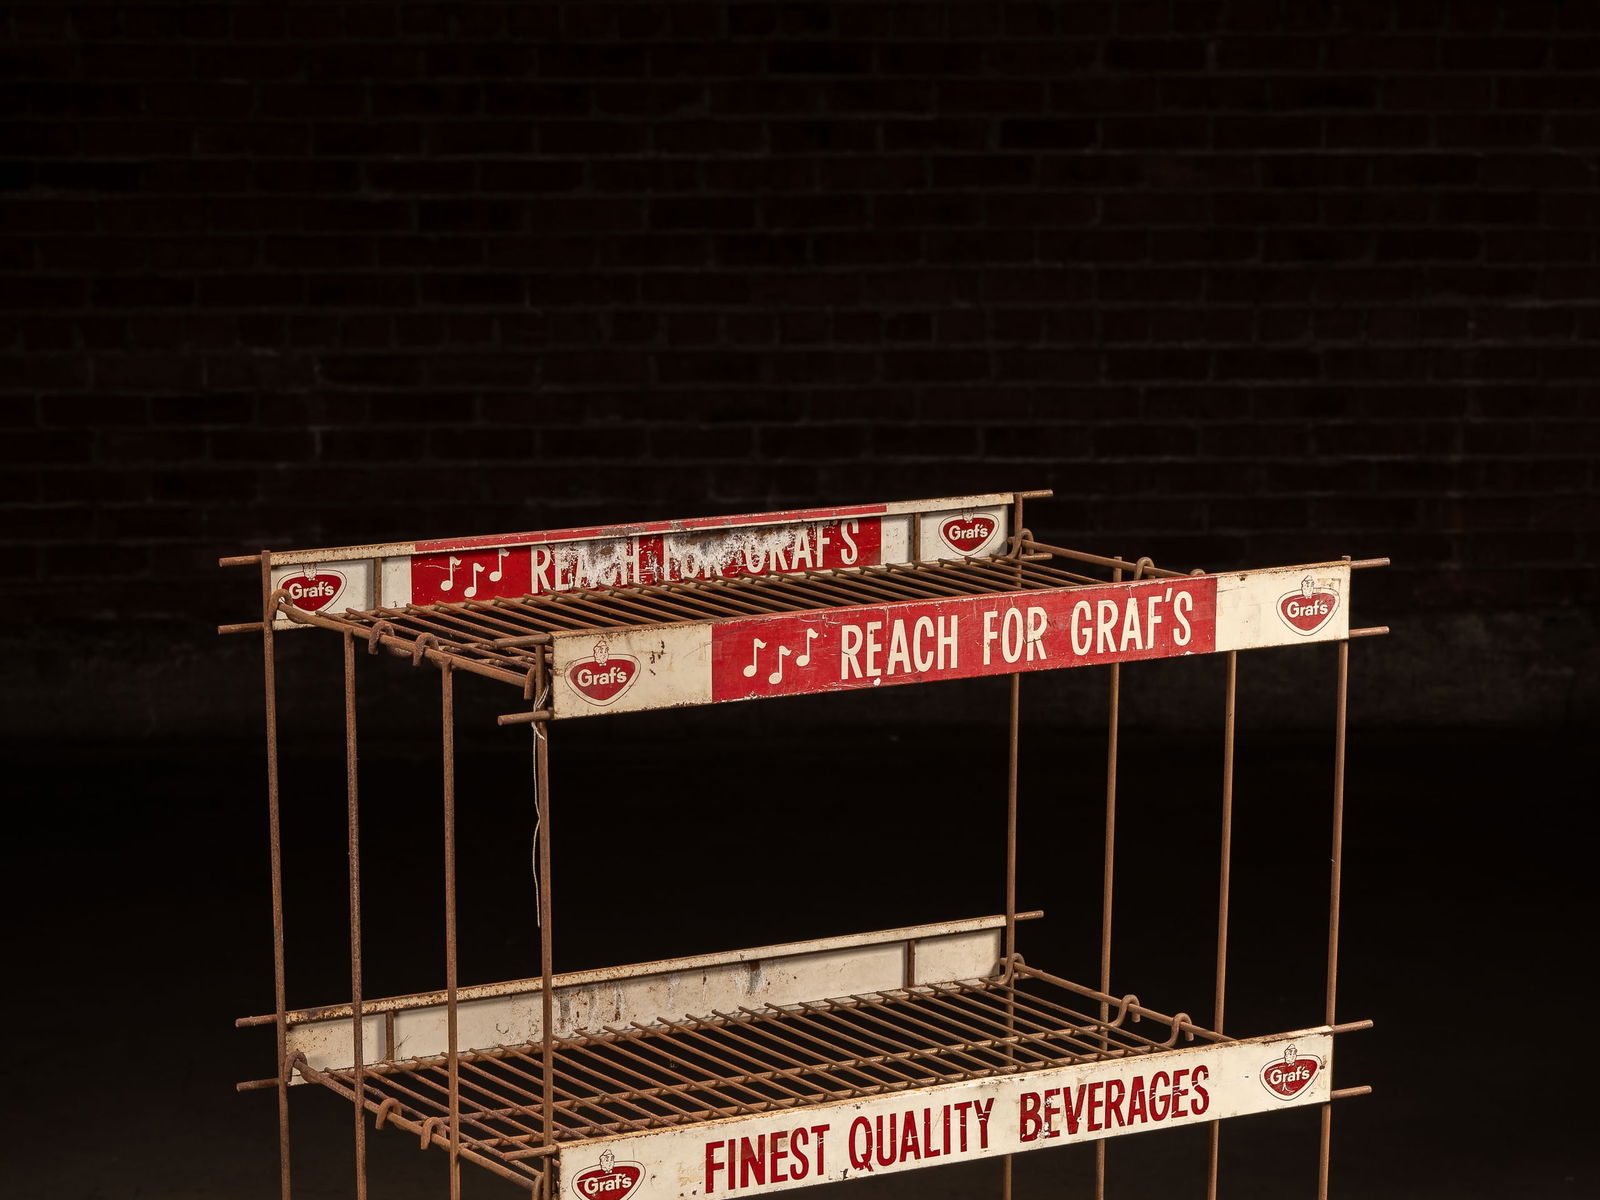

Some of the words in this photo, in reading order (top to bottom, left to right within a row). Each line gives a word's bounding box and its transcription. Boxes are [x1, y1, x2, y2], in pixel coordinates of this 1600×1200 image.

[942, 524, 989, 541] Graf's
[288, 580, 335, 600] Graf's
[1286, 600, 1329, 618] Graf's
[840, 614, 959, 680] REACH
[983, 606, 1049, 665] FOR
[1070, 588, 1194, 656] GRAF'S
[577, 667, 628, 687] Graf's
[1270, 1065, 1310, 1086] Graf's
[705, 1124, 831, 1194] FINEST
[848, 1097, 995, 1172] QUALITY
[1020, 1065, 1210, 1143] BEVERAGES
[583, 1173, 633, 1196] Graf's
